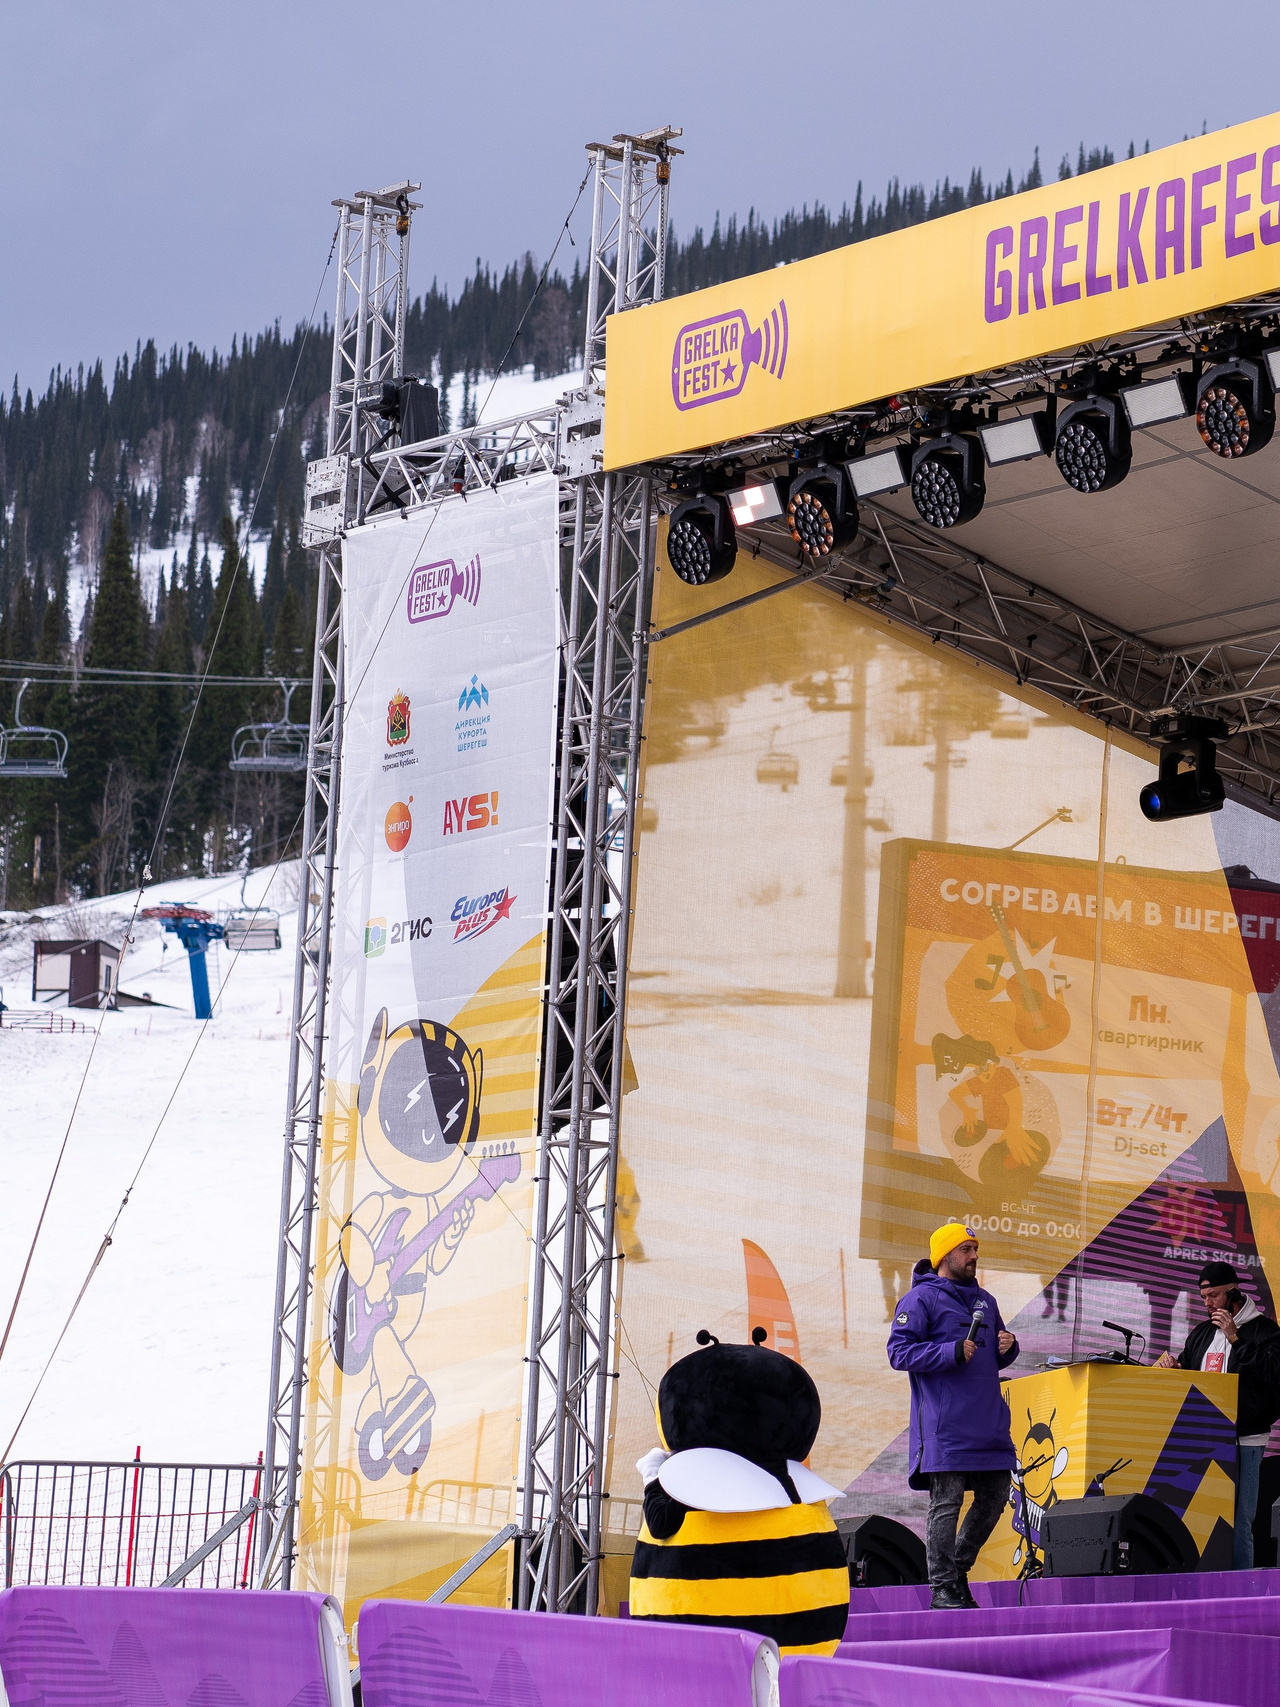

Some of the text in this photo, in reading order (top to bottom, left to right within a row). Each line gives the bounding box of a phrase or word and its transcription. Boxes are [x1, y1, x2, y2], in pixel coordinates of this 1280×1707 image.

[683, 322, 738, 365] GRELKA
[683, 360, 721, 398] FEST
[415, 567, 450, 593] GRELKA
[413, 592, 437, 615] FEST
[455, 714, 491, 731] ДИРЕКЦИЯ
[457, 739, 488, 752] ШЕРЕГЕШ
[458, 728, 487, 741] КУРОРТА
[384, 748, 414, 761] Министерство
[940, 878, 1133, 925] СОГРЕВАЕМ
[1144, 902, 1163, 926] В
[390, 916, 433, 944] 2ГИС
[1128, 994, 1172, 1025] Пн.
[1114, 1136, 1168, 1158] Dj-set
[962, 1213, 1013, 1233] 10:00
[1017, 1223, 1040, 1238] до
[1164, 1246, 1266, 1268] APRES SKI BAR
[1120, 1551, 1125, 1559] 4
